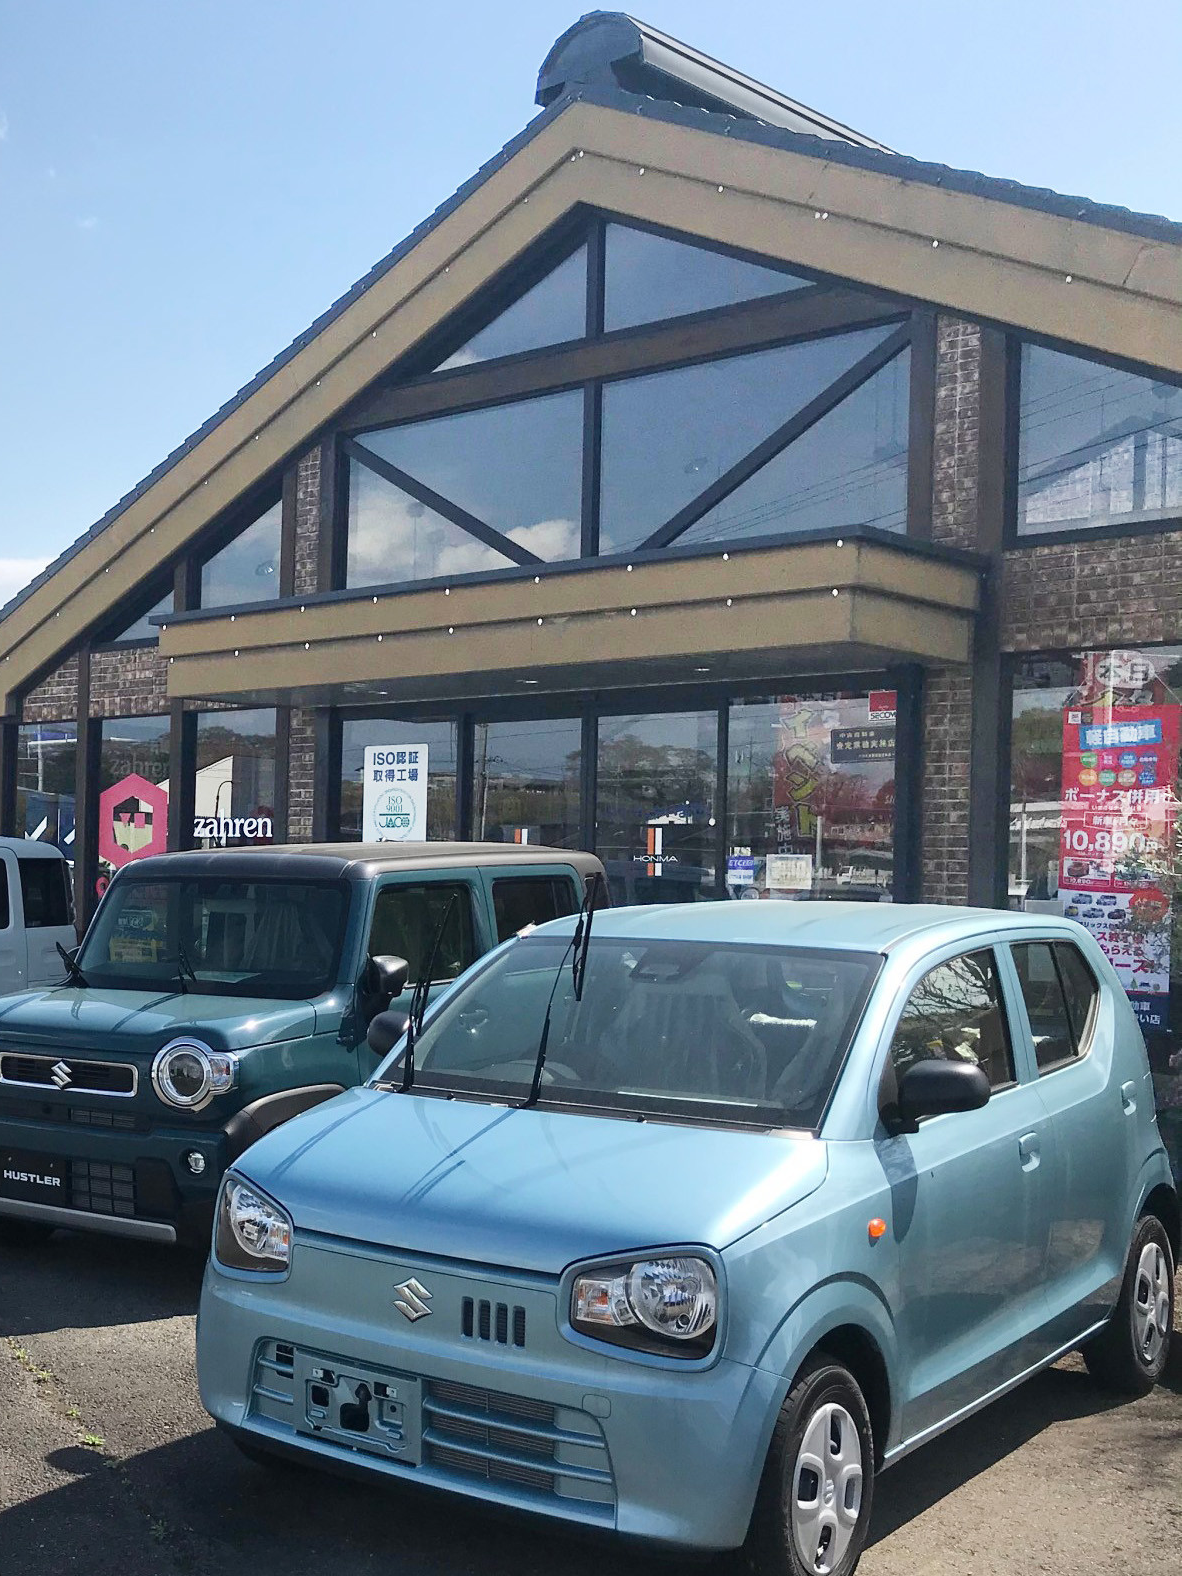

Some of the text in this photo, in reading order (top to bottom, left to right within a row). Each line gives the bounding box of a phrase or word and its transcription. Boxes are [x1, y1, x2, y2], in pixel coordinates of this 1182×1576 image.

[373, 751, 419, 766] ISO認証
[373, 768, 419, 783] 取得工場
[388, 795, 403, 805] ISO
[193, 808, 273, 838] zahren
[3, 1169, 61, 1187] HUSTLER
